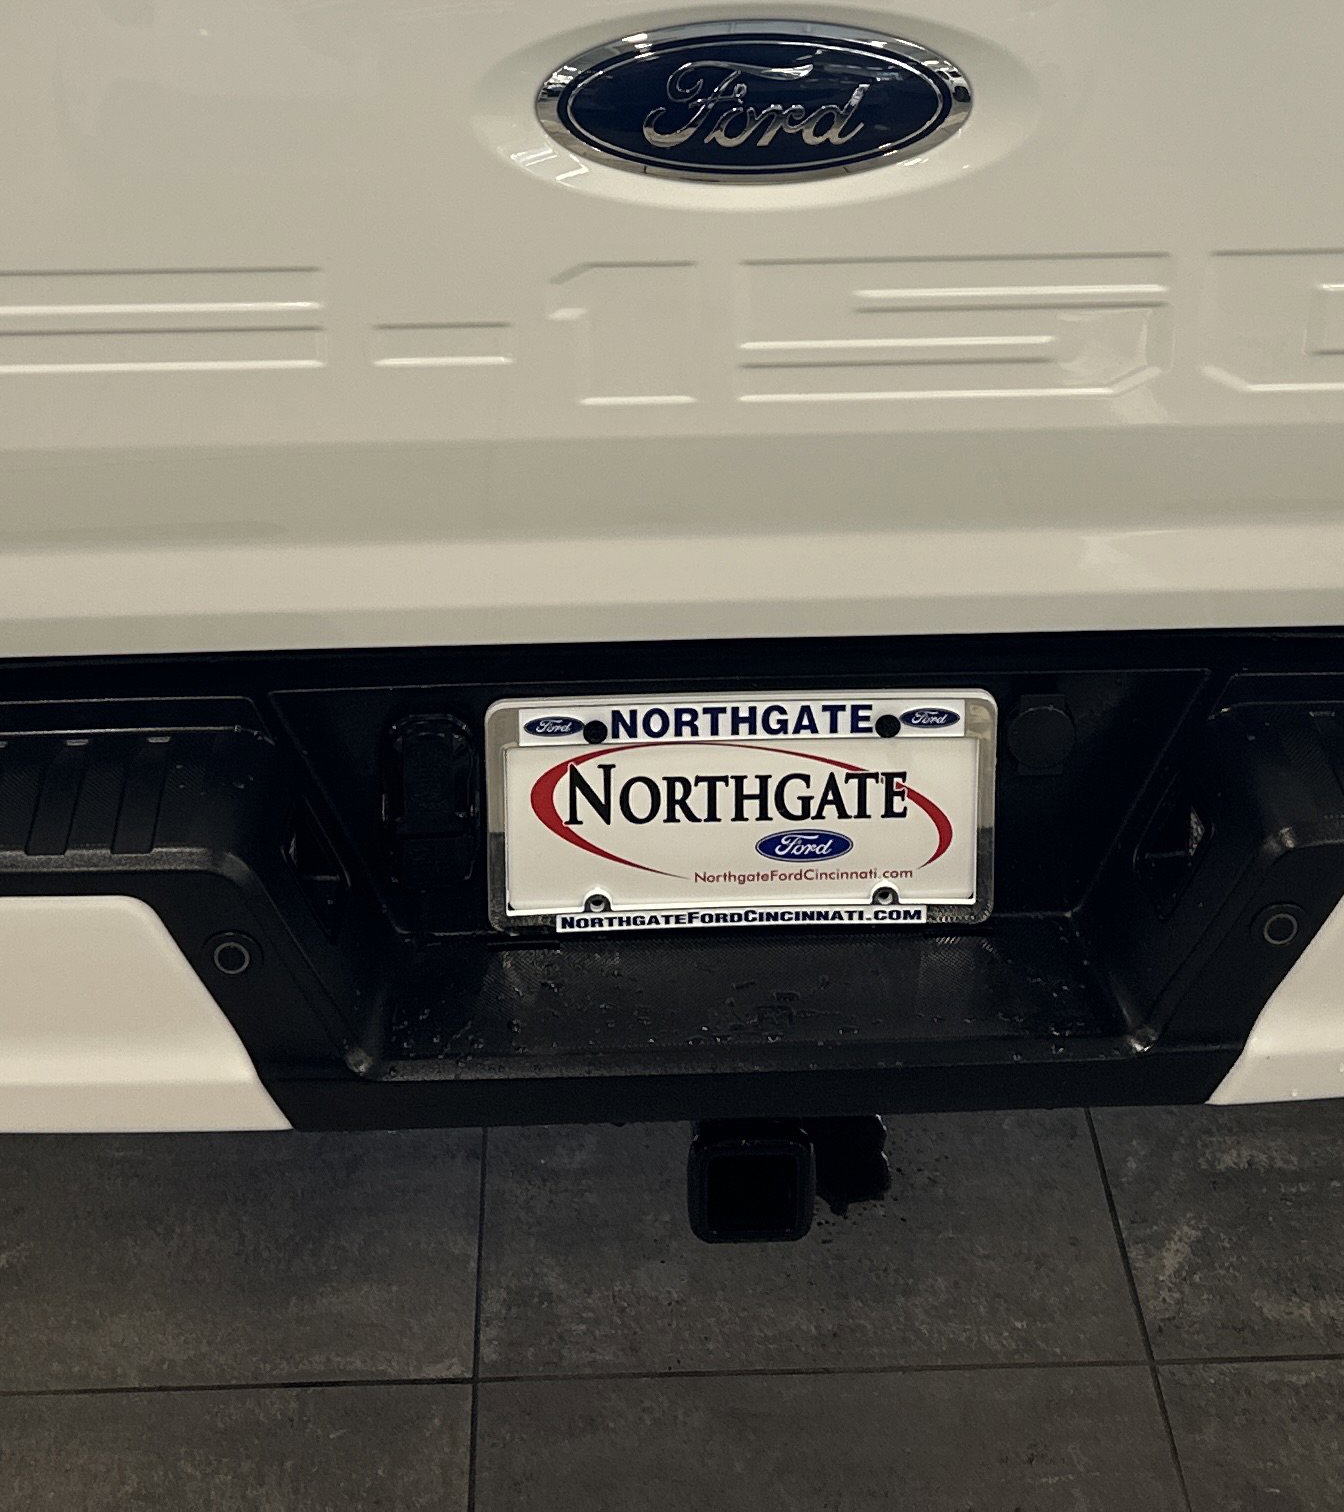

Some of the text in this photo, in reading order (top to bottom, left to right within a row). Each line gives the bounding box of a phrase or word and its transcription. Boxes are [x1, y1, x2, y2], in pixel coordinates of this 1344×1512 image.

[643, 60, 871, 148] Ford
[610, 704, 874, 740] NORTHGATE
[565, 763, 909, 827] NORTHGATE
[694, 867, 914, 885] NorthgateFordCincinnati.com
